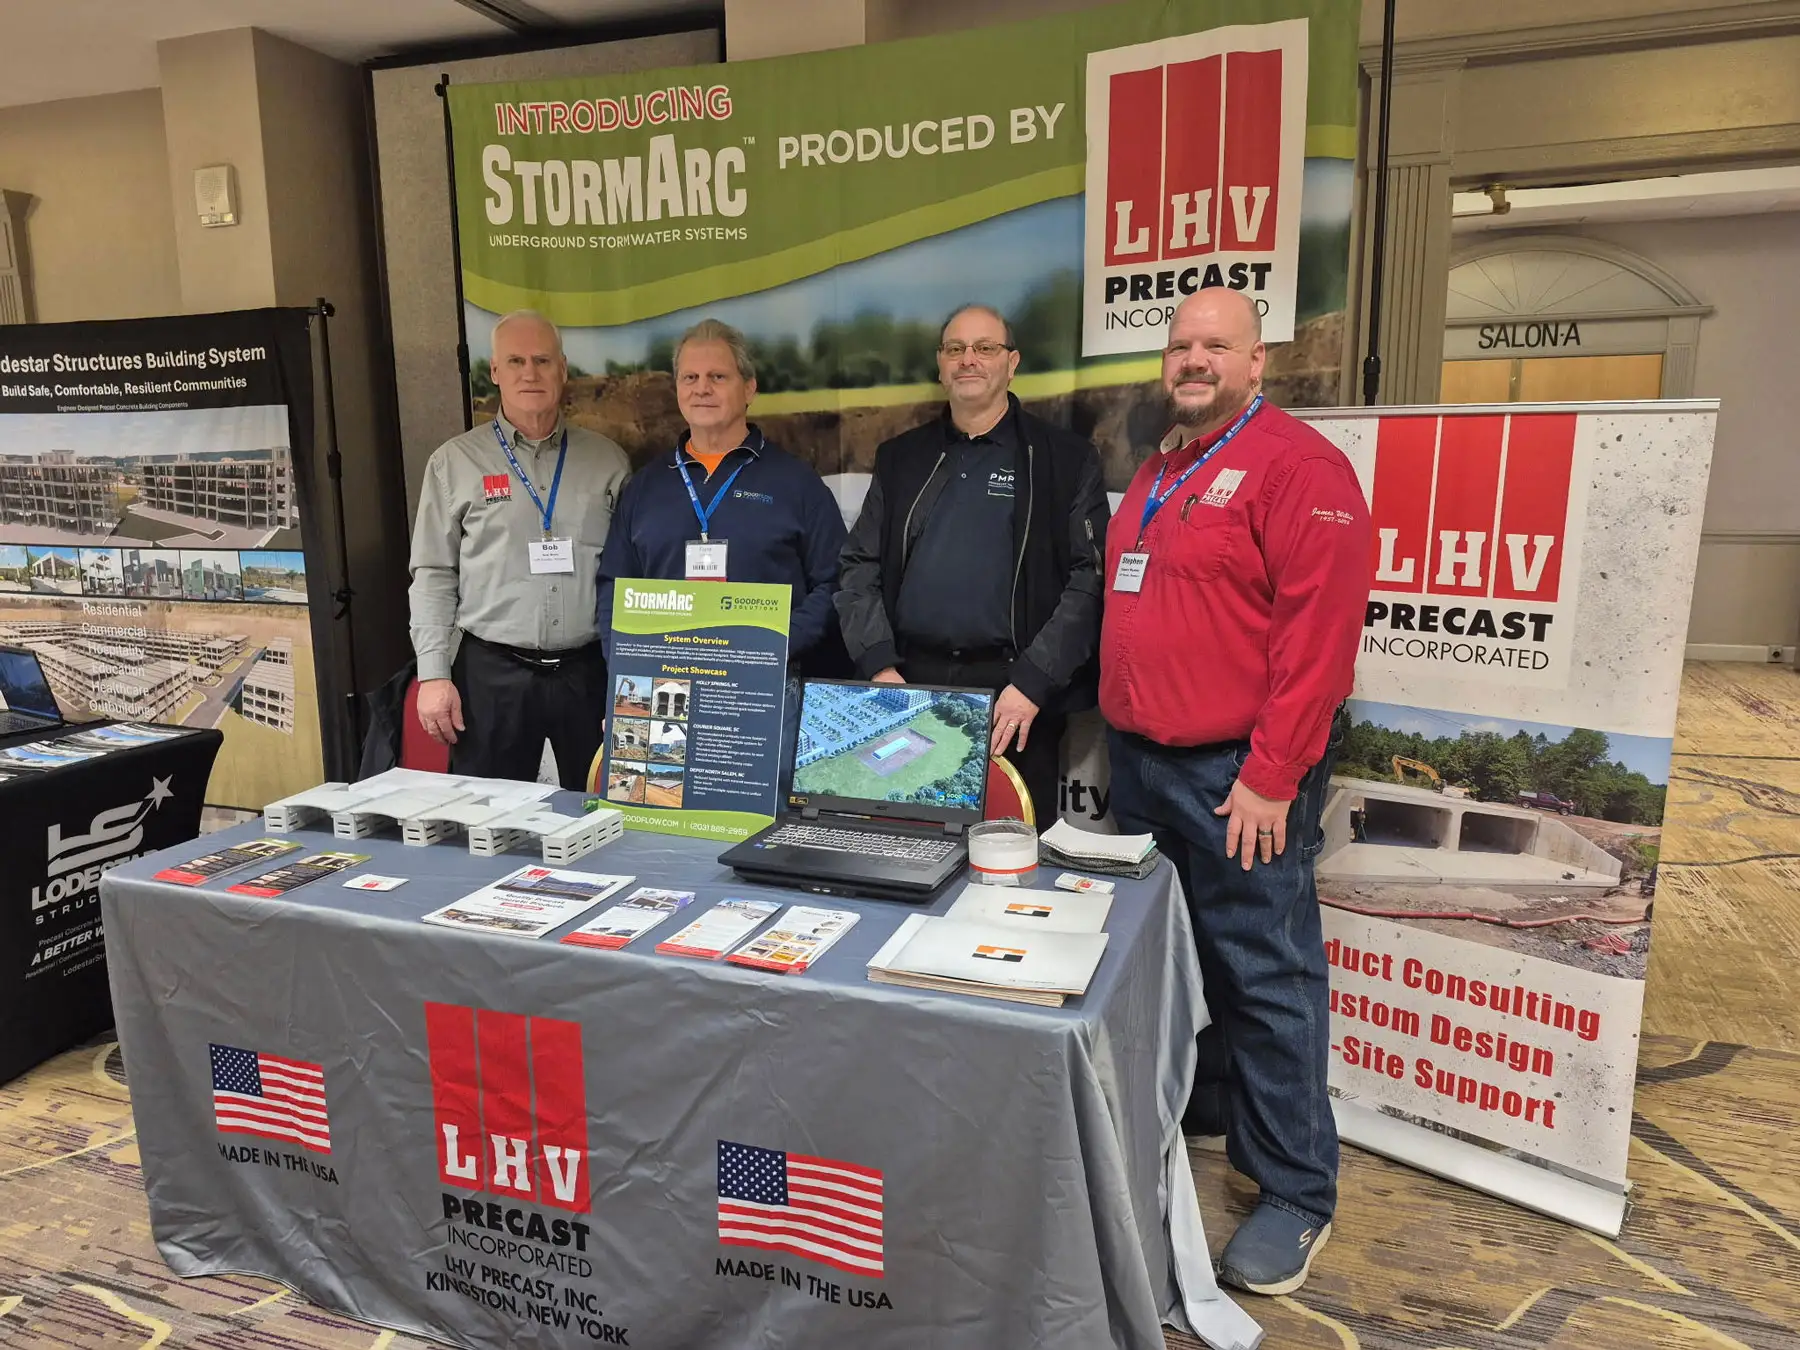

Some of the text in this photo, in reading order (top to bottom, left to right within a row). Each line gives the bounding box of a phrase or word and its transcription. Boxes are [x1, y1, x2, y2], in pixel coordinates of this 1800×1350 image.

[495, 84, 733, 136] INTRODUCING
[778, 102, 1066, 169] PRODUCED BY
[489, 226, 748, 249] UNDERGROUND STORMWATER SYSTEMS
[1113, 186, 1271, 256] LHV
[1104, 262, 1272, 304] PRECAST
[1105, 298, 1270, 331] INCORD
[53, 353, 142, 372] Structures
[146, 350, 207, 369] Building
[209, 346, 266, 368] System
[2, 376, 248, 398] Build Safe, Comfortable, Resilient Communities
[990, 473, 1015, 482] PMP
[1122, 556, 1144, 565] Stephen
[1375, 528, 1555, 592] LHV
[82, 602, 142, 618] Residential
[734, 597, 778, 606] GOODFLOW
[82, 622, 147, 638] Commercial
[664, 634, 729, 646] System Overview
[1363, 602, 1554, 643] PRECAST
[88, 641, 145, 660] Hospitality
[1363, 635, 1549, 671] INCORPORATED
[91, 661, 145, 677] Education
[661, 664, 728, 676] Project Showcase
[91, 680, 149, 697] Healthcare
[89, 700, 156, 718] Outbuildings
[690, 823, 710, 831] (203)
[31, 952, 41, 967] A
[44, 930, 93, 960] BETTER
[1402, 957, 1600, 1042] Consulting
[1430, 1014, 1554, 1077] Design
[1415, 1058, 1556, 1130] Support
[217, 1142, 340, 1185] MADE IN THE USA
[442, 1123, 581, 1202] LHV
[442, 1192, 591, 1252] PRECAST
[448, 1225, 593, 1279] INCORPORATED
[445, 1254, 604, 1317] LHV PRECAST, INC.
[715, 1257, 894, 1310] MADE IN THE USA
[426, 1271, 630, 1347] KINGSTON, NEW YORK
